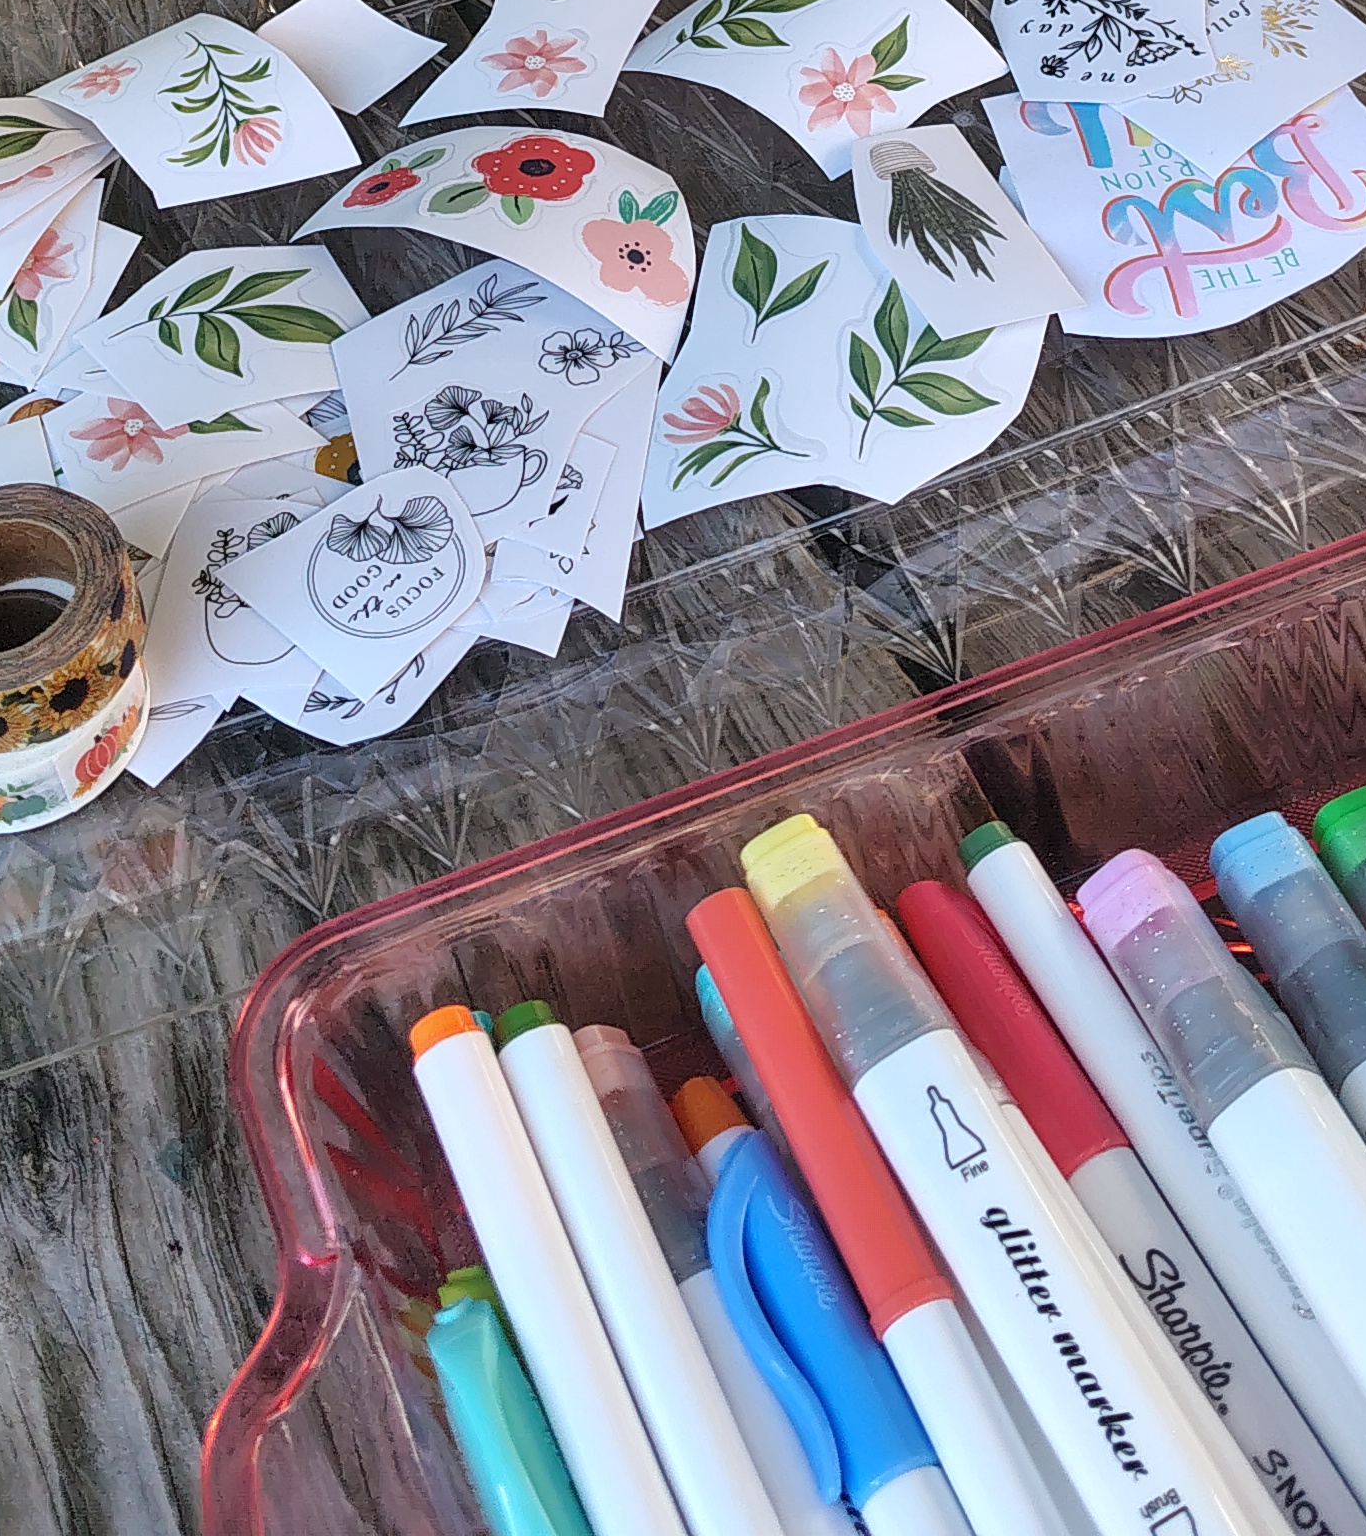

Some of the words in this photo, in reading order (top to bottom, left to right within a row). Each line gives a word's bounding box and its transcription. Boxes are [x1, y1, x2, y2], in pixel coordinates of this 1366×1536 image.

[1019, 20, 1071, 39] day
[1079, 71, 1137, 85] one
[1137, 142, 1175, 168] OF
[1099, 158, 1197, 193] RSION
[1271, 246, 1301, 268] BE
[1193, 263, 1263, 291] THE
[332, 564, 383, 610] GOOD
[385, 566, 447, 619] FOCUS
[961, 1158, 991, 1184] Fine
[764, 1190, 840, 1312] Sharpie
[979, 1205, 1063, 1323] glitter
[1052, 1331, 1150, 1482] marker
[1117, 1246, 1235, 1419] Sharpie
[1139, 1487, 1183, 1520] Brush
